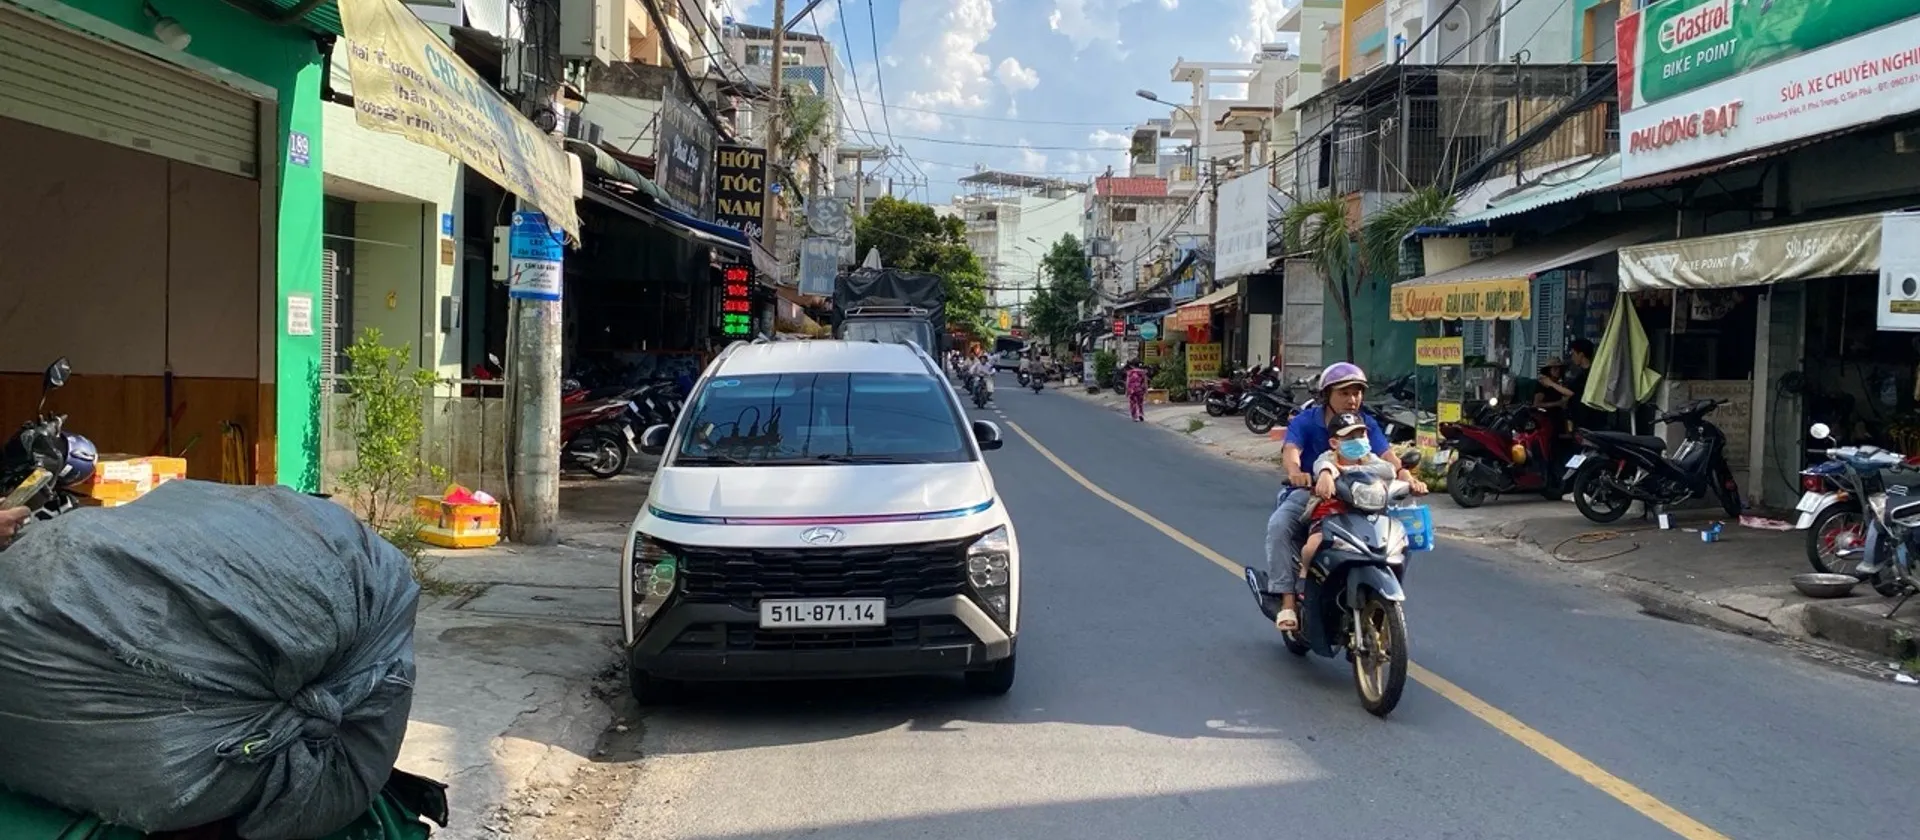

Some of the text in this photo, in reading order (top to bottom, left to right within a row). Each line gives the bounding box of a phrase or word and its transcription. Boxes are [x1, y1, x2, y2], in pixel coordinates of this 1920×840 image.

[1676, 0, 1729, 44] Castrol
[1663, 38, 1738, 79] BIKE POINT
[1781, 46, 1920, 102] SỬA XE CHUYÊN NGHI
[1629, 99, 1744, 155] PHƯƠNG ĐẠT
[291, 134, 308, 155] 189
[720, 149, 763, 169] HỚT
[721, 172, 761, 193] TÓC
[718, 199, 761, 217] NAM
[1701, 257, 1728, 269] POINT
[771, 604, 874, 622] 51L-871.14
